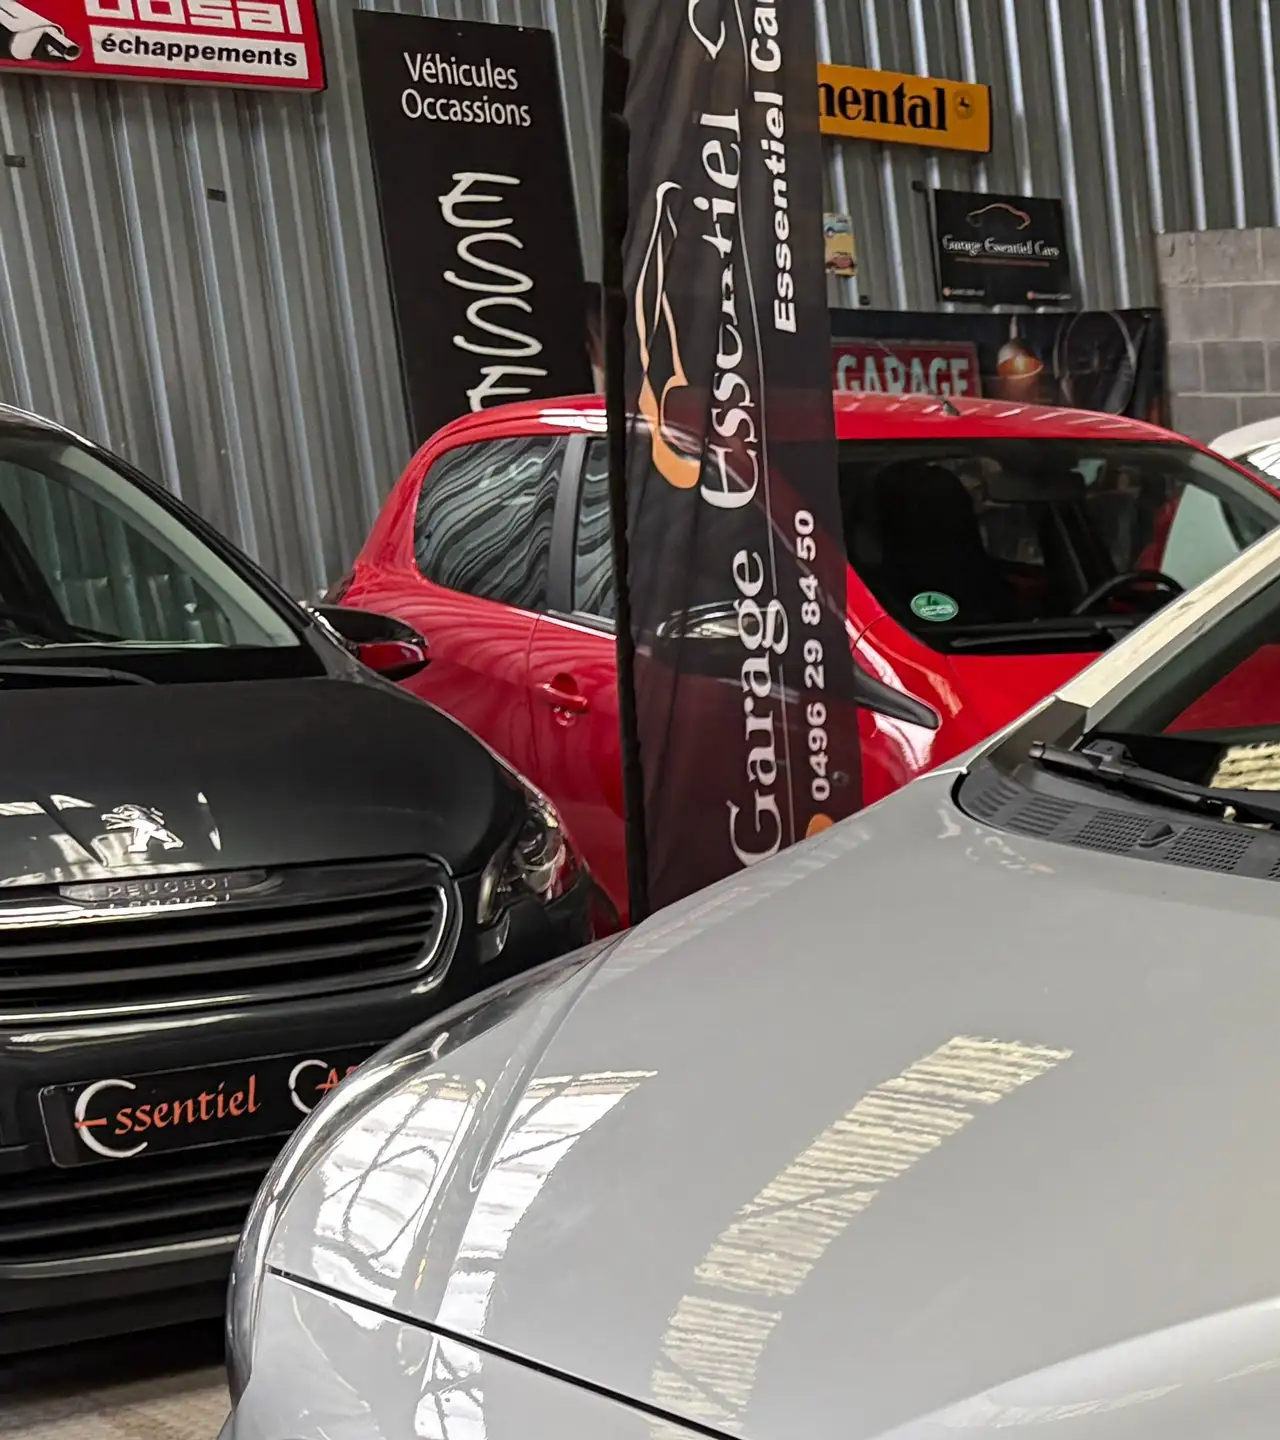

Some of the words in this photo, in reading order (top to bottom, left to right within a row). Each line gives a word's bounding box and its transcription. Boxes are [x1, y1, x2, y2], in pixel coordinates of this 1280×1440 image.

[101, 33, 298, 67] échappements
[403, 51, 519, 90] Véhicules
[401, 88, 532, 127] Occassions
[753, 91, 797, 333] Essentiel
[836, 354, 970, 398] GARAGE
[795, 509, 817, 562] 50
[799, 574, 822, 626] 84
[803, 638, 825, 690] 29
[726, 550, 789, 867] Garage
[806, 702, 830, 801] 0496
[107, 876, 231, 898] PEUGEOT
[74, 1074, 261, 1158] Essentiel
